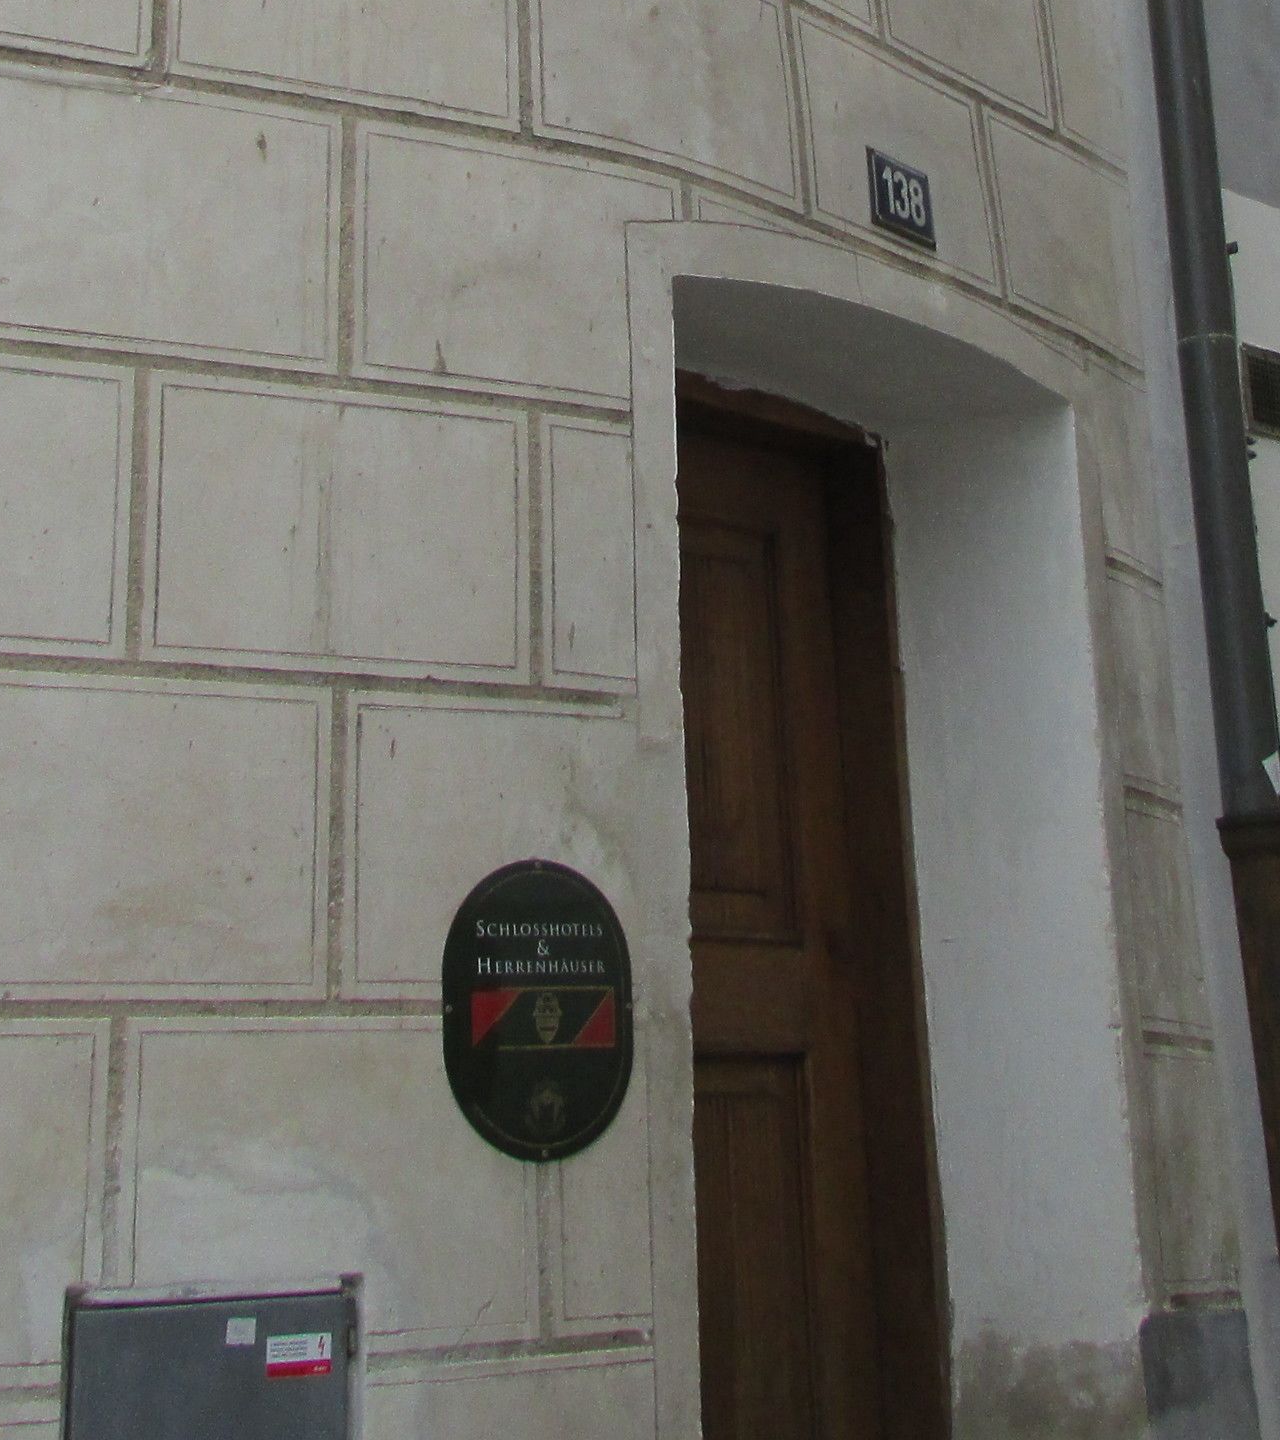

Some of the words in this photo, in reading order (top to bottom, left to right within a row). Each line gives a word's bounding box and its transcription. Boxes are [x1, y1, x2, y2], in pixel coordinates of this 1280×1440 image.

[882, 165, 926, 228] 138
[476, 919, 603, 937] SCHLOSSHOTELS
[536, 939, 550, 956] &
